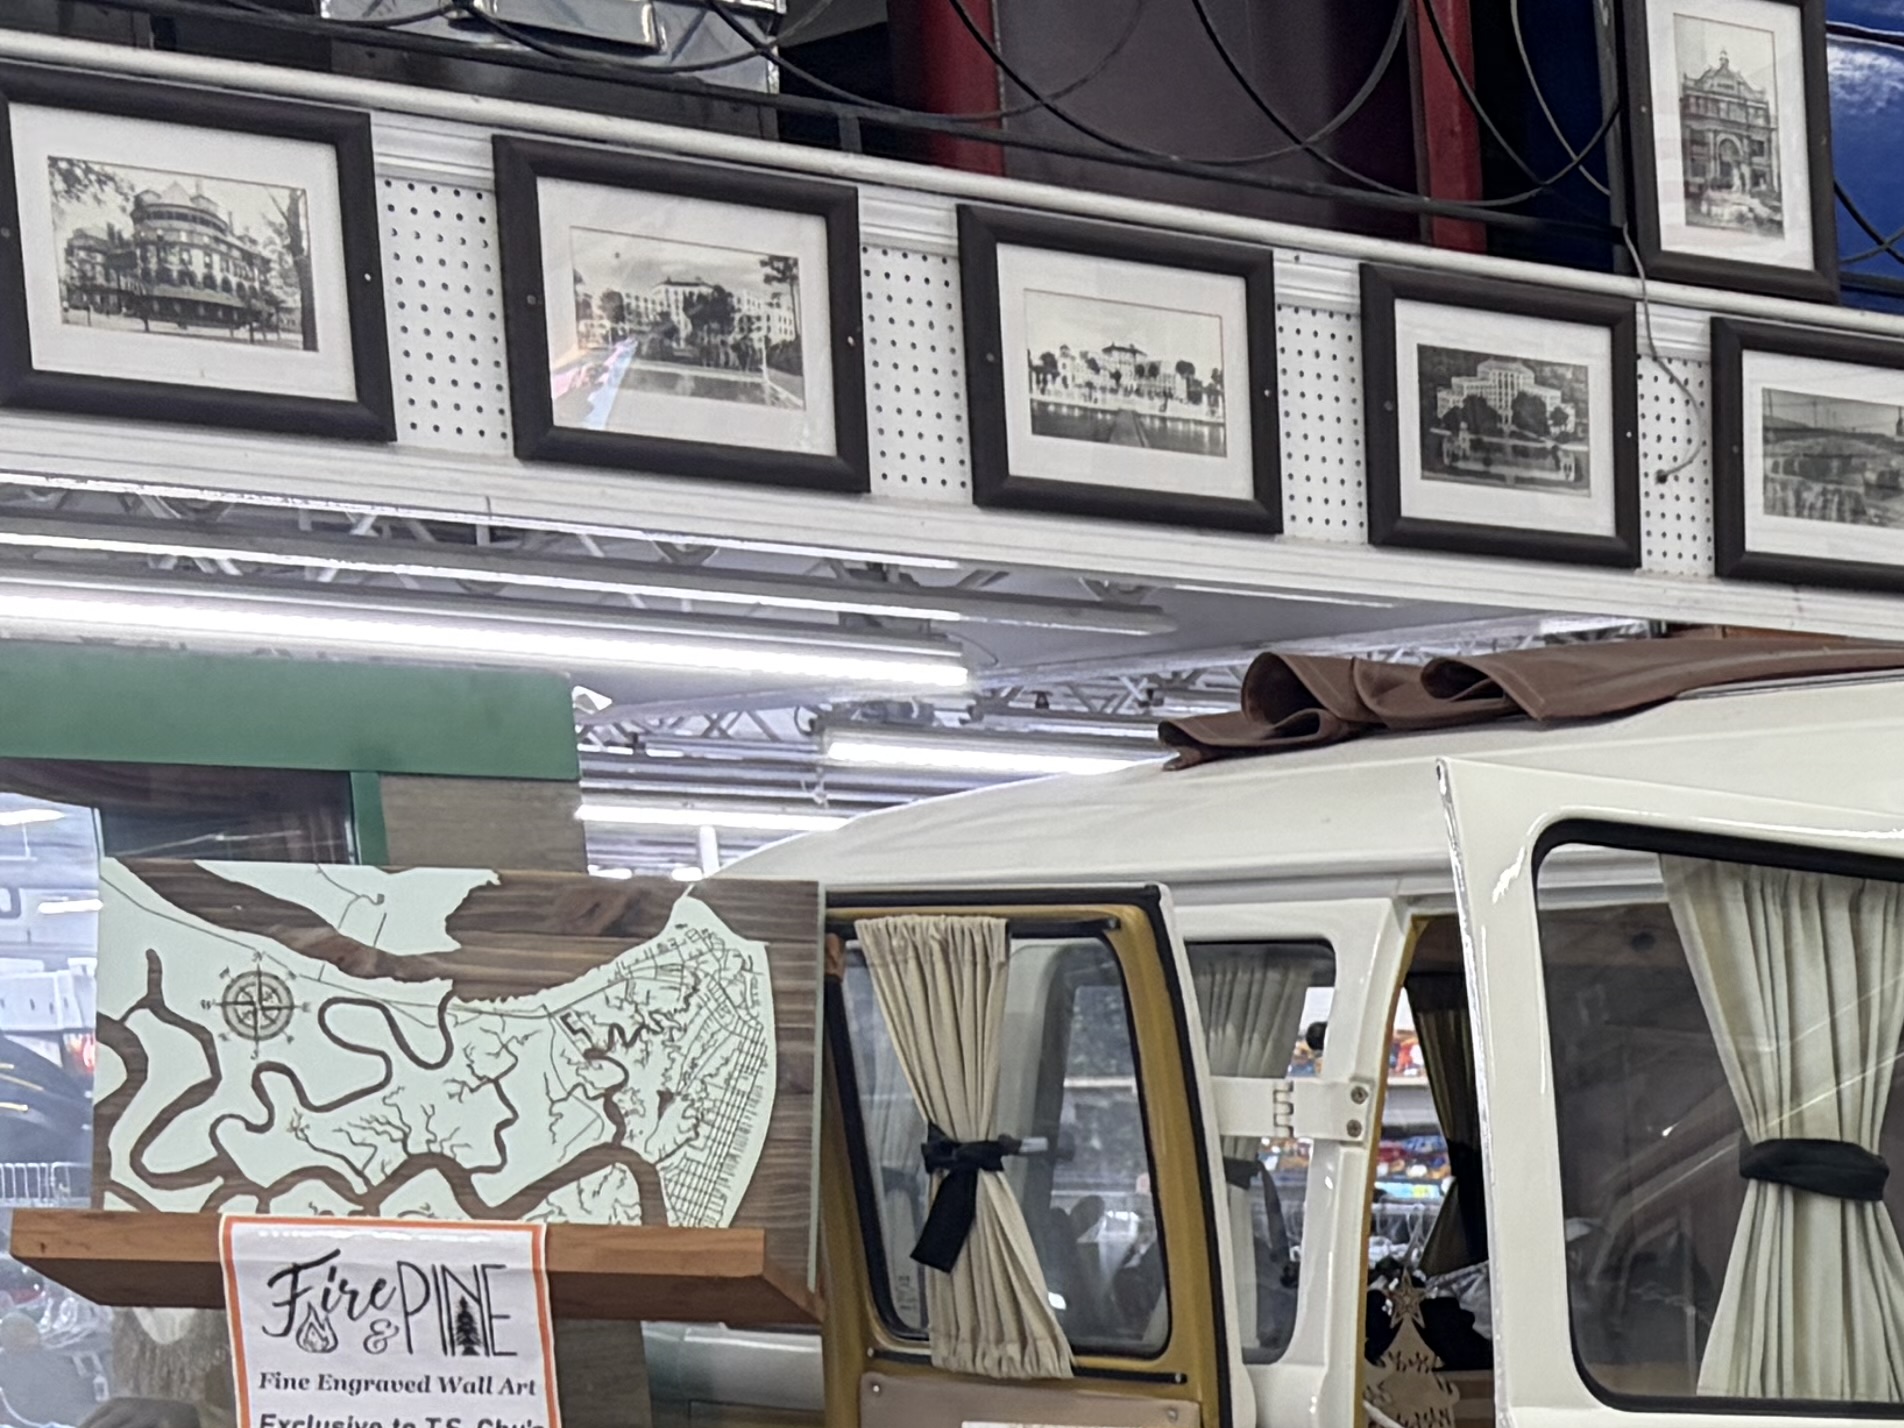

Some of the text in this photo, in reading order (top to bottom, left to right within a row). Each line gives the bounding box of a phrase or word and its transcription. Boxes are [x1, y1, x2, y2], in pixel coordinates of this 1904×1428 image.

[262, 1248, 397, 1338] Fire
[396, 1260, 518, 1358] PINE
[258, 1371, 537, 1397] Fine Engraved Wall Art
